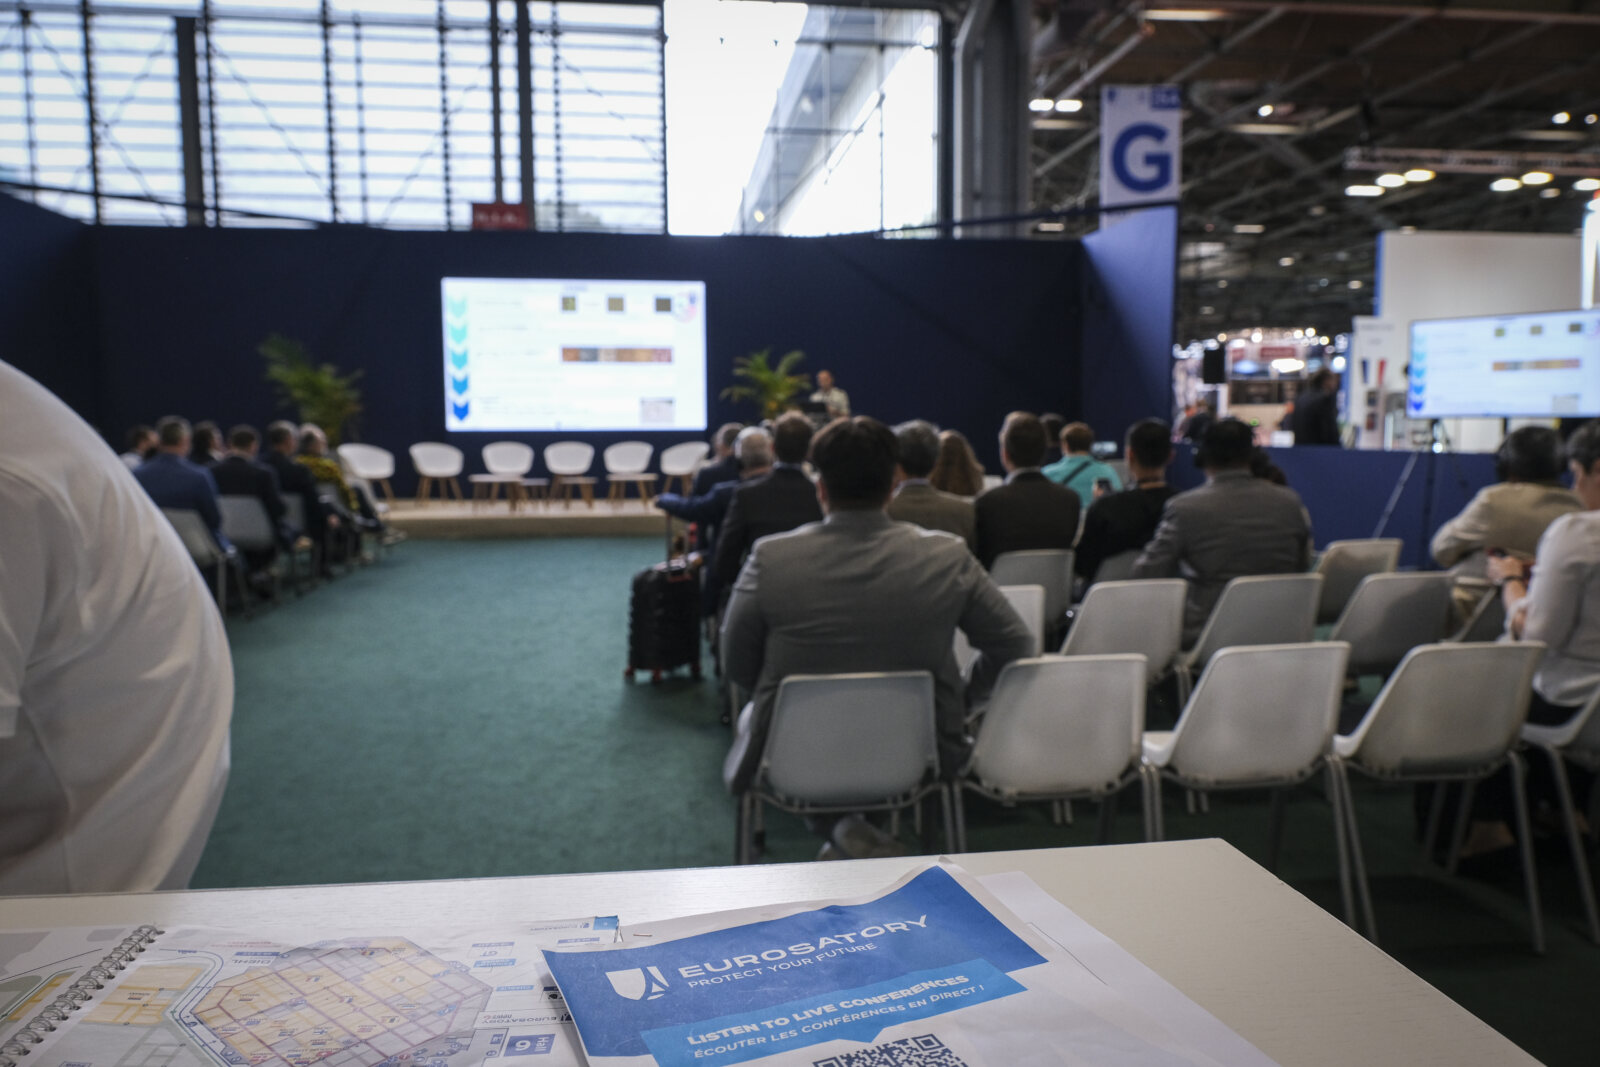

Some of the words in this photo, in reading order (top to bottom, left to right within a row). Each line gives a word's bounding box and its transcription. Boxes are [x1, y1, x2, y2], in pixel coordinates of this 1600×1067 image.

[1111, 121, 1172, 194] G
[678, 914, 928, 979] EUROSATORY
[688, 968, 763, 988] PROTECT
[767, 957, 813, 973] YOUR
[816, 943, 877, 962] FUTURE
[687, 1023, 759, 1046] LISTEN
[761, 1016, 791, 1031] TO
[791, 1003, 838, 1022] LIVE
[839, 975, 970, 1010] CONFERENCES
[694, 1036, 767, 1059] ÉCOUTER
[771, 1028, 798, 1043] LES
[801, 1003, 906, 1034] CONFÉRENCES
[908, 998, 928, 1010] EN
[930, 985, 977, 1003] DIRECT
